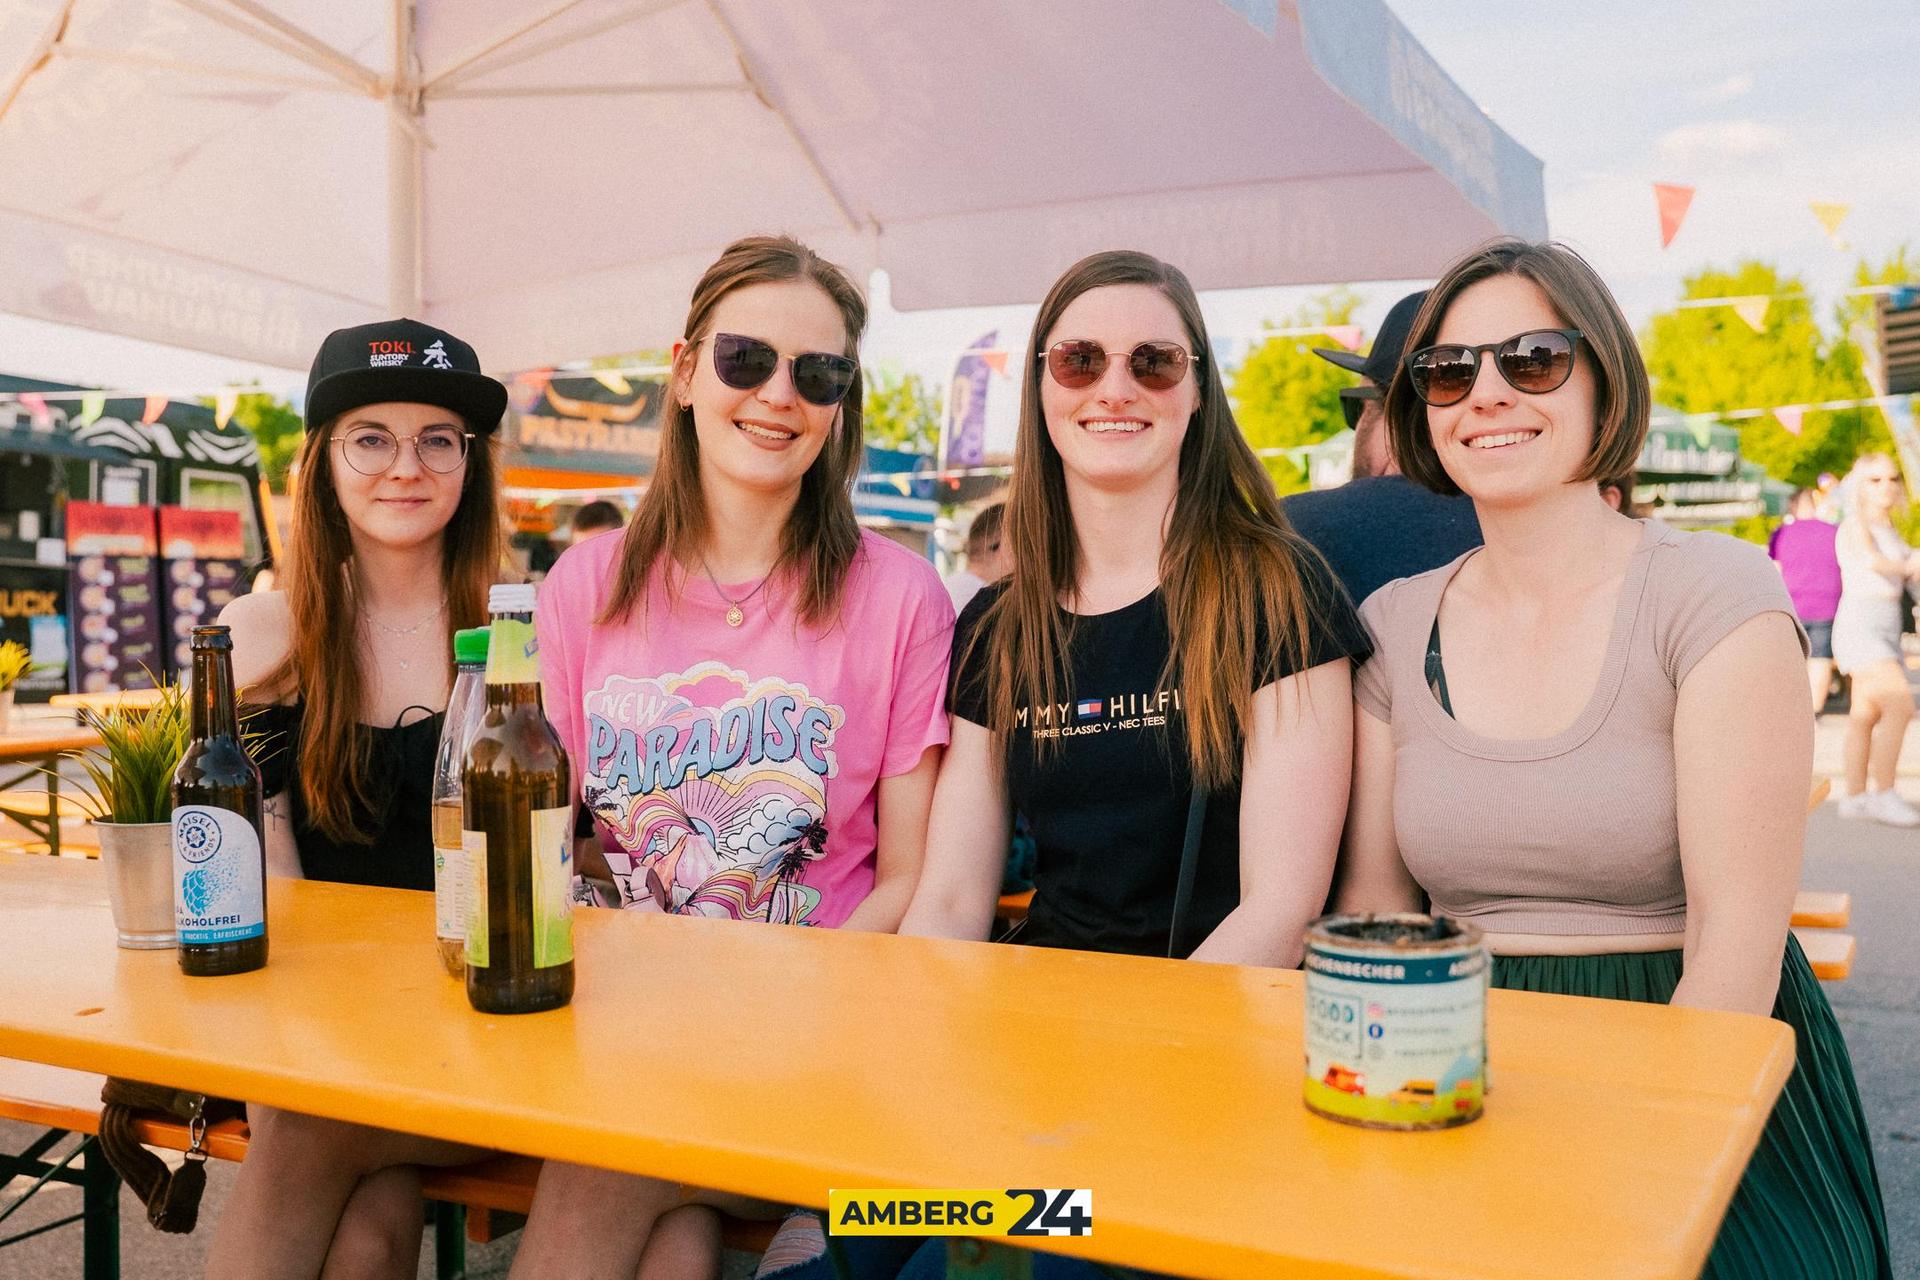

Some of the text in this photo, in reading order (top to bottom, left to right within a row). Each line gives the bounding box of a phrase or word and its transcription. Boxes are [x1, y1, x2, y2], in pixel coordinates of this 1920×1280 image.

[368, 340, 412, 355] TOKI
[370, 353, 409, 362] SUNTORY
[370, 359, 404, 368] WHISKY
[0, 589, 58, 618] UCK
[602, 691, 669, 727] NEW
[1014, 688, 1180, 728] MMY HILFI
[1033, 728, 1060, 739] THREE
[1062, 722, 1102, 737] CLASSIC
[1102, 722, 1111, 731] V
[1119, 718, 1140, 731] NEC
[1142, 715, 1165, 727] TEES
[589, 695, 832, 796] PARADISE
[179, 815, 211, 838] MAISEL
[188, 838, 216, 857] FRIENDS
[178, 914, 241, 927] KOHOLFREI
